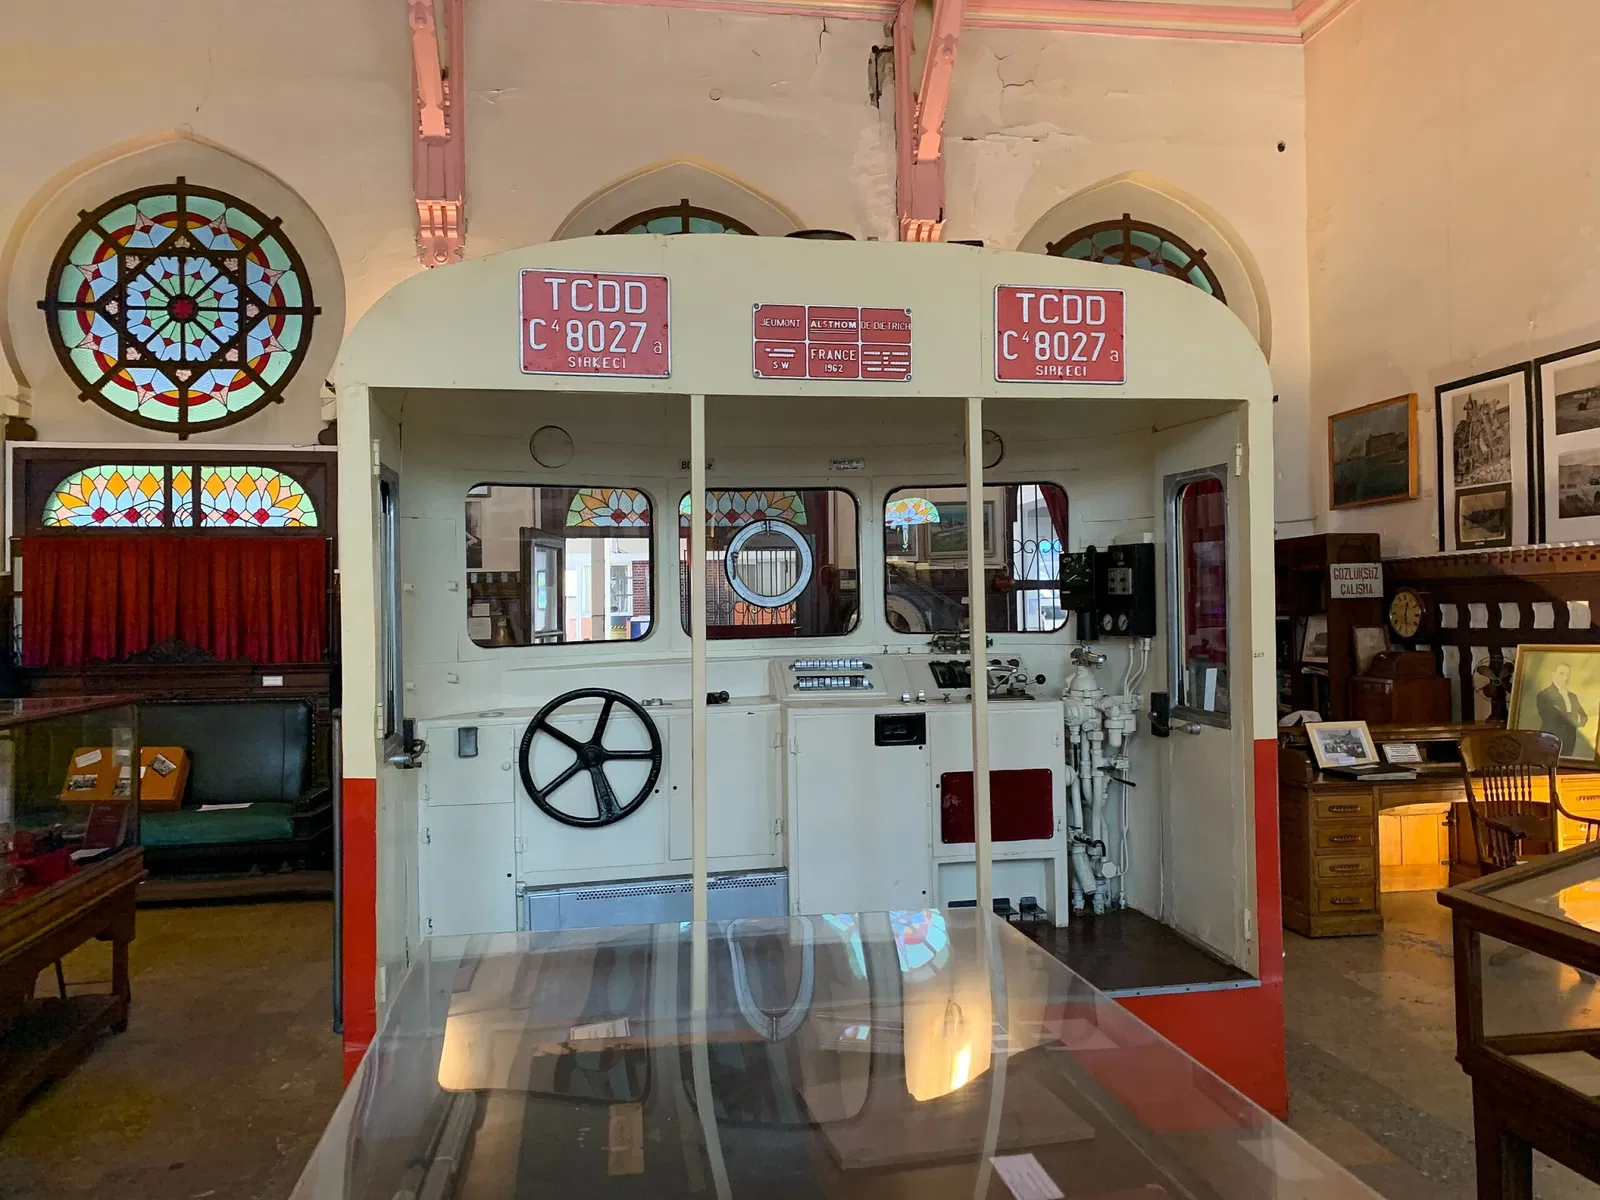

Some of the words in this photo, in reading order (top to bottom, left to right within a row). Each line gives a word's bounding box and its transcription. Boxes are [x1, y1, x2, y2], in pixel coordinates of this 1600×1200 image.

[544, 277, 647, 314] TCDD
[1016, 293, 1106, 325] TCDD
[760, 317, 801, 327] JEUMONT
[810, 320, 857, 329] ALSTHOM
[873, 321, 911, 331] DIETRICH
[566, 319, 647, 353] 8027
[1034, 330, 1106, 361] 8027
[810, 348, 857, 361] FRANCE
[824, 364, 844, 373] 1962
